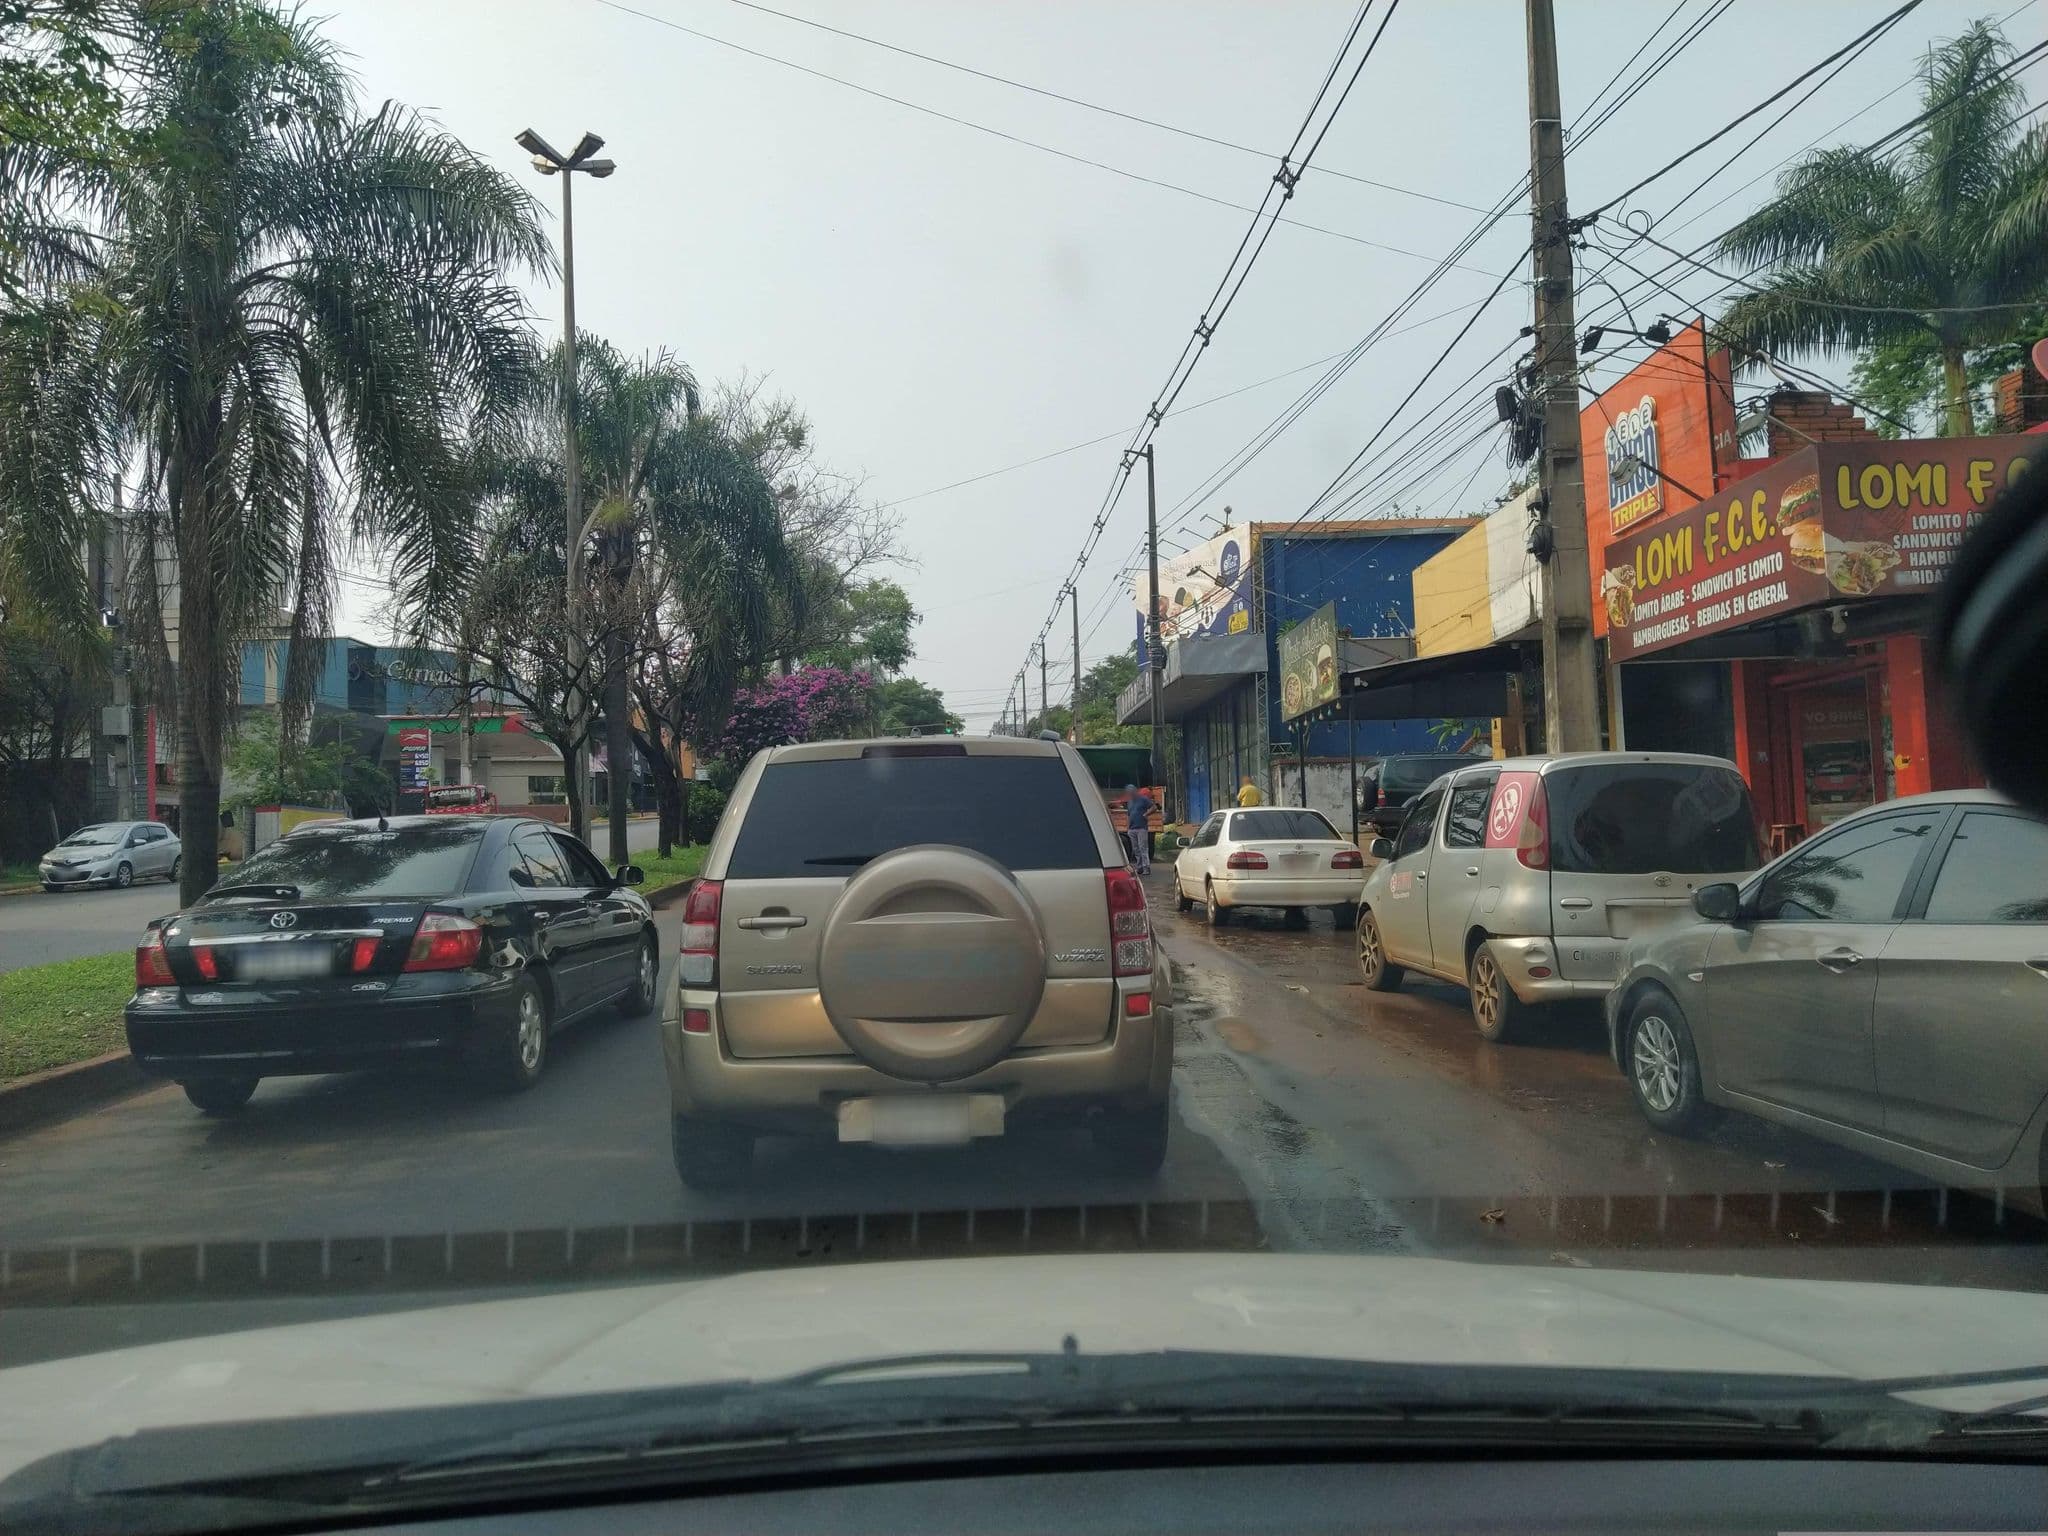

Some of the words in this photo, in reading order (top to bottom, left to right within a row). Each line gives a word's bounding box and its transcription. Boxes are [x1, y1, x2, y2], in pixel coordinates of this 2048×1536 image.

[1607, 404, 1651, 452] TELE
[1837, 463, 1947, 509] LOMI
[1613, 491, 1656, 527] TRIPLE
[1912, 514, 1962, 530] LOMITO
[1635, 526, 1693, 590] LOMI
[1893, 532, 1962, 549] SANDWICH
[1634, 599, 1659, 623] LOMITO
[1660, 589, 1685, 614] ÁRABE
[1691, 573, 1733, 603] SANDWICH
[1736, 568, 1747, 586] DE
[1749, 551, 1783, 582] LOMITO
[1633, 615, 1690, 648] HAMBURGUESAS
[1697, 603, 1731, 628] BEBIDAS
[1733, 596, 1745, 615] EN
[1747, 580, 1789, 611] GENERAL
[744, 965, 804, 976] SUZUKI
[1054, 953, 1105, 962] VITARA
